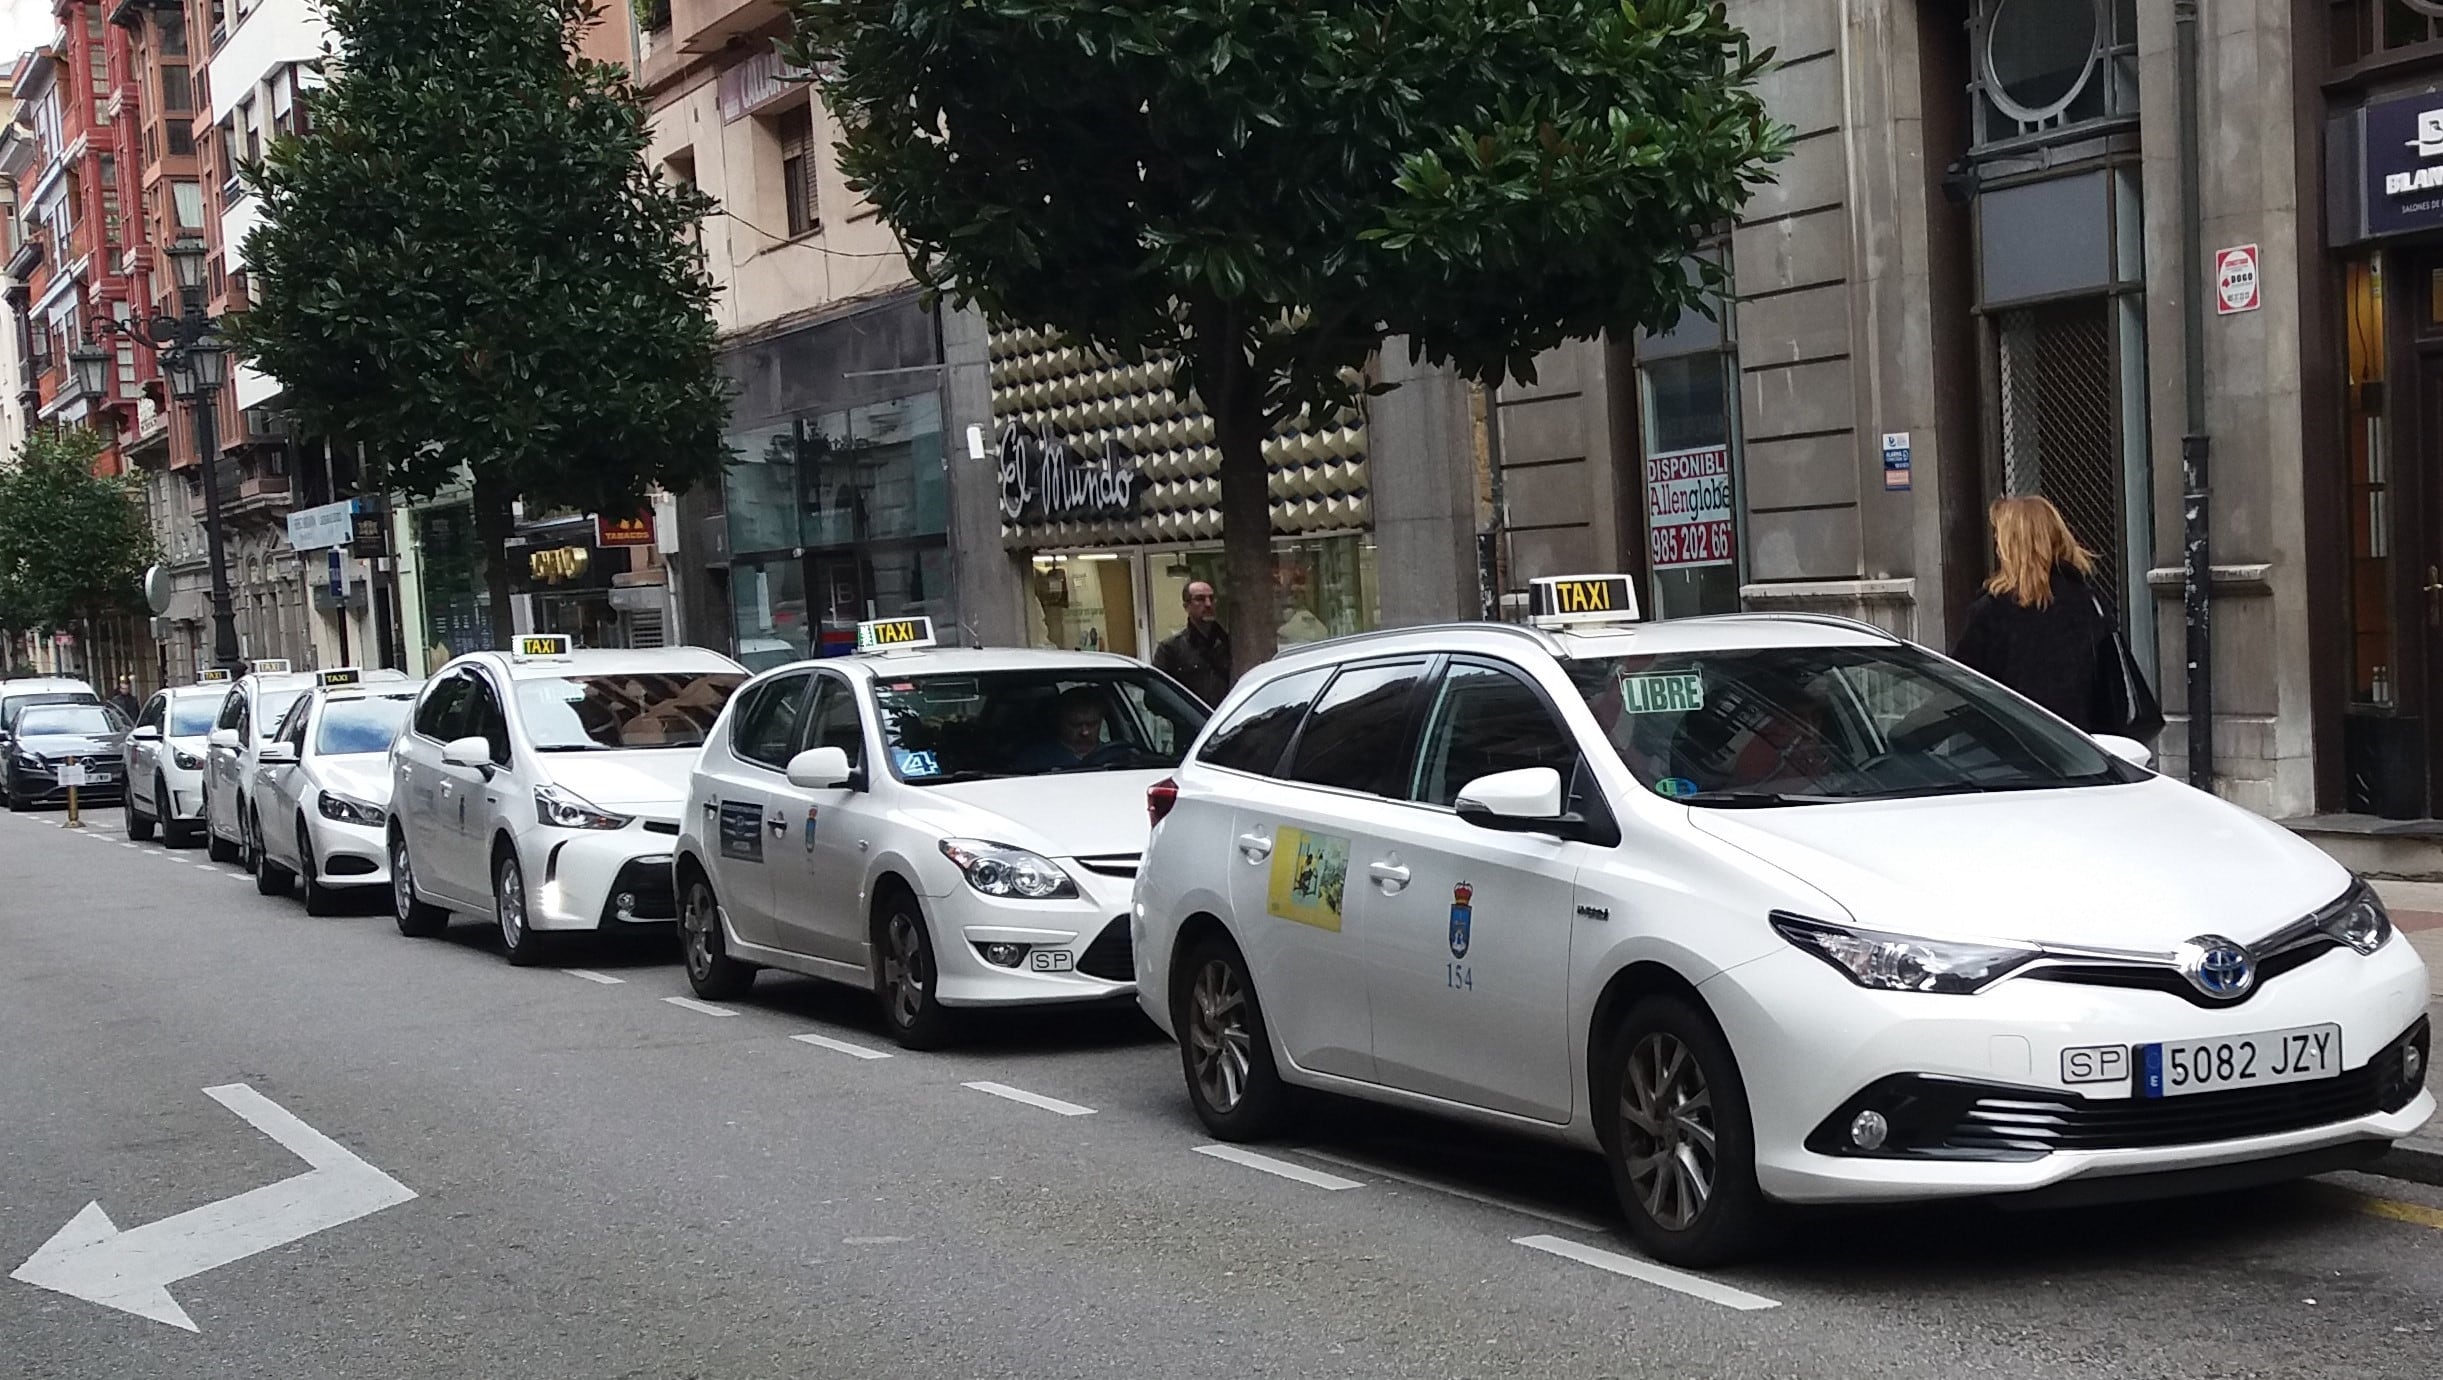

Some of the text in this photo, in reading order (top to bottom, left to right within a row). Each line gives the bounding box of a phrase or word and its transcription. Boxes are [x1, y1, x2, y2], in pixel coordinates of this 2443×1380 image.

[2402, 201, 2430, 214] SALONES
[2431, 199, 2440, 208] DE
[1000, 422, 1134, 518] El Mundo
[605, 532, 649, 540] TABACOS
[1652, 522, 1731, 563] 985 202 66
[1557, 581, 1610, 611] TAXI
[875, 622, 914, 643] TAXI
[524, 639, 555, 653] TAXI
[260, 662, 280, 671] TAXI
[205, 672, 222, 680] TAXI
[326, 674, 349, 682] TAXI
[1625, 676, 1700, 711] LIBRE
[1036, 953, 1068, 969] SP
[1446, 963, 1472, 991] 154
[2070, 1050, 2120, 1078] SP
[2171, 1041, 2257, 1086] 5082
[2271, 1032, 2330, 1075] JZY
